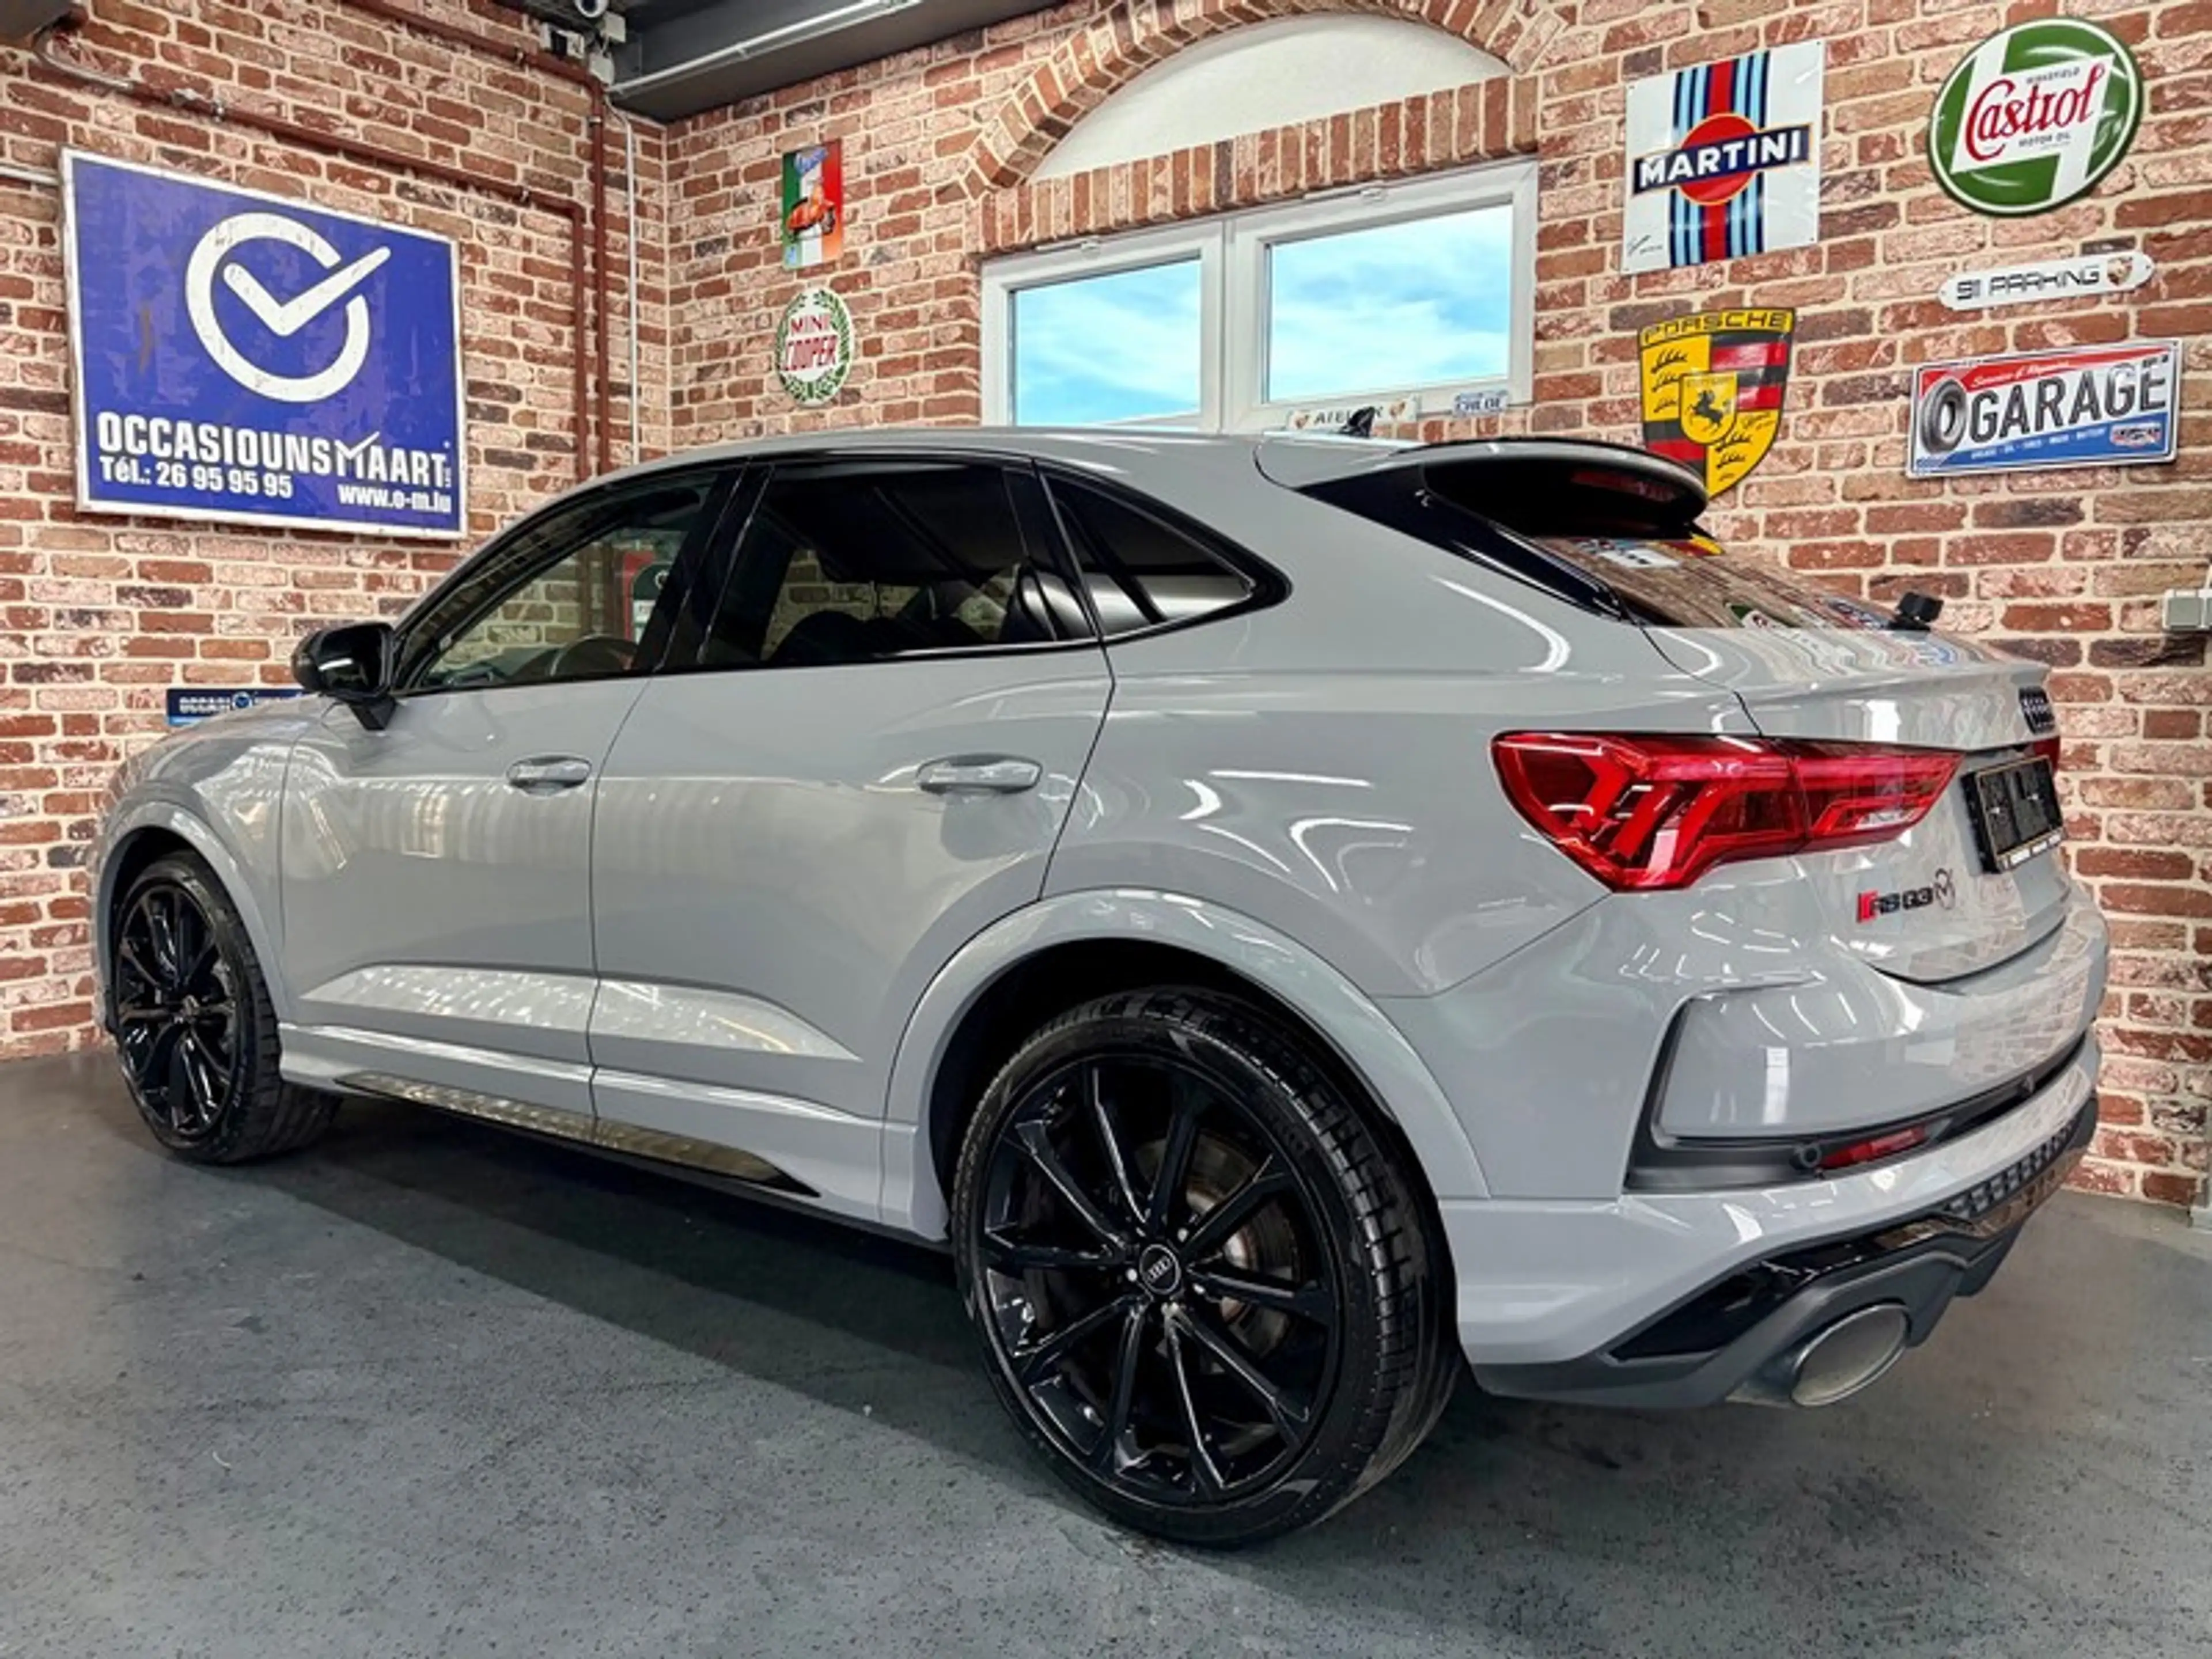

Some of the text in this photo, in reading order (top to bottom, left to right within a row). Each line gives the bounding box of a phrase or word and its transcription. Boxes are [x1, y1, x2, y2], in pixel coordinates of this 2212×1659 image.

[1965, 63, 2105, 161] Castrol
[1639, 130, 1802, 188] MARTINI
[1989, 265, 2100, 297] PARKING
[1644, 312, 1785, 345] PORSCHE
[1969, 354, 2169, 444] GARAGE
[155, 461, 187, 488] 26
[192, 464, 224, 492] 95
[228, 468, 259, 496] 95
[263, 472, 293, 499] 95
